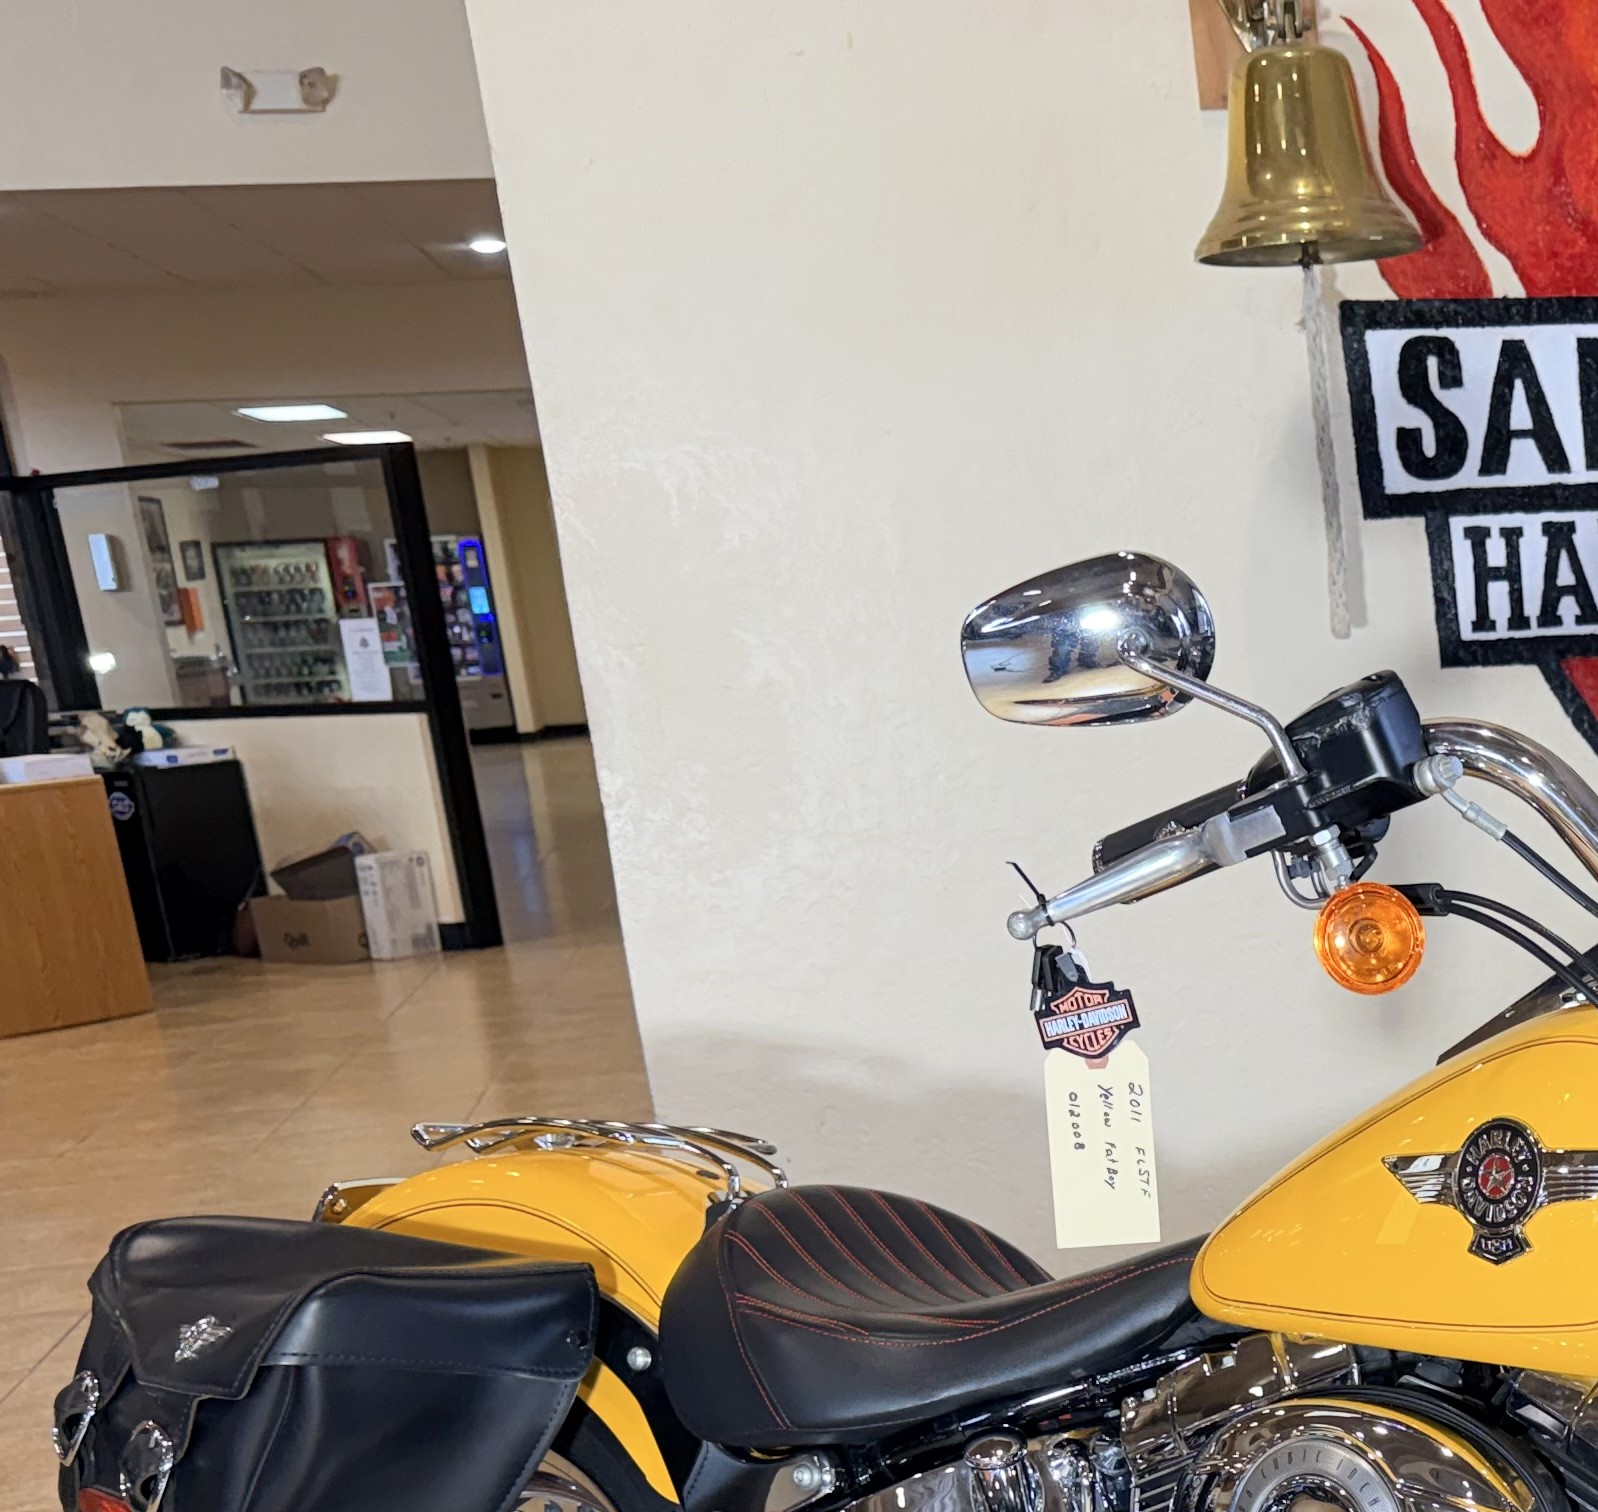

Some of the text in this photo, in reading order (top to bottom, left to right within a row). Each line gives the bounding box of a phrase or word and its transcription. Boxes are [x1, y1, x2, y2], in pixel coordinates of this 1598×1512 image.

[1043, 1003, 1129, 1038] HARLEY-DAVIDSON
[1058, 991, 1104, 1014] MOTOR
[1068, 1027, 1114, 1052] CYCLES
[1068, 1090, 1086, 1151] 012008
[1097, 1083, 1115, 1128] Yellow
[1127, 1082, 1144, 1123] 2011
[1465, 1128, 1533, 1164] HARLEY
[1461, 1176, 1534, 1223] DAVIDSON
[1260, 1447, 1323, 1479] CUBIC
